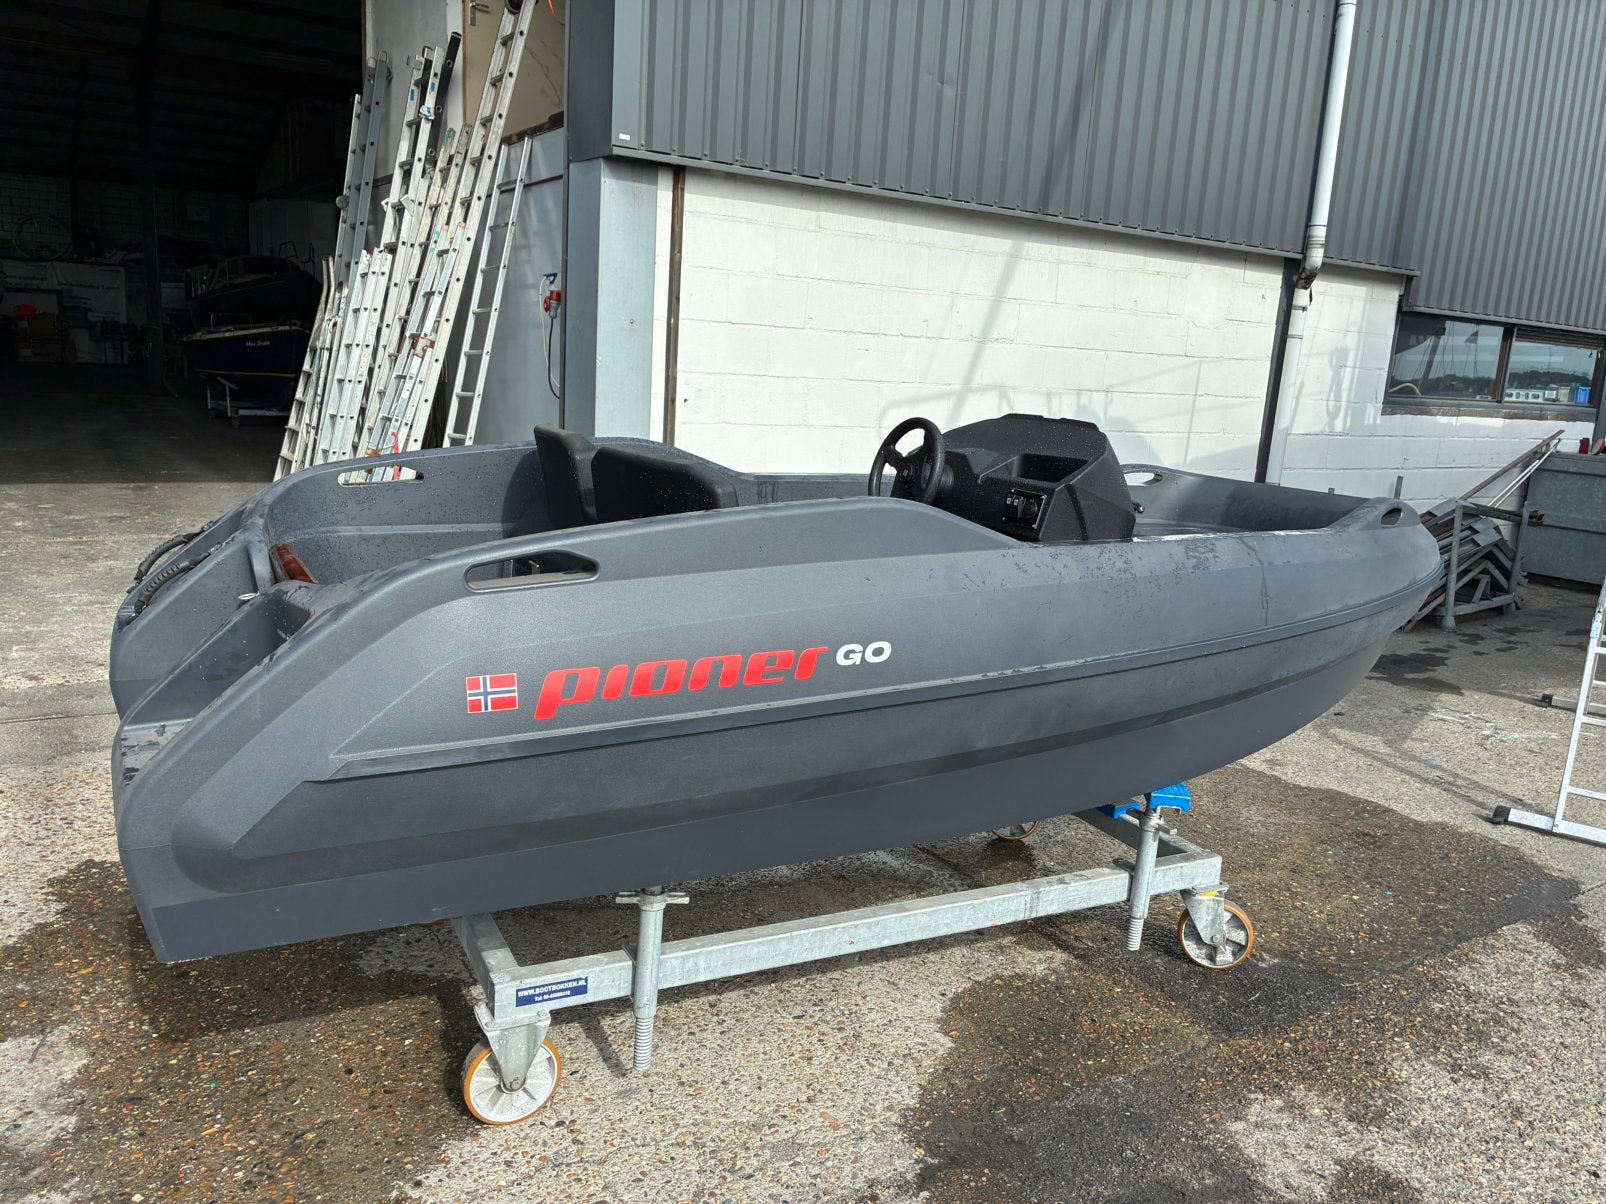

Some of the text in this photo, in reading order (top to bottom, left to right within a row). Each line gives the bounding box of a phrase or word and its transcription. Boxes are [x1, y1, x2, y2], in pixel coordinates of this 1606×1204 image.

[533, 641, 892, 721] pioner GO
[517, 980, 587, 997] WWW.BOOTBOKKEN.NL
